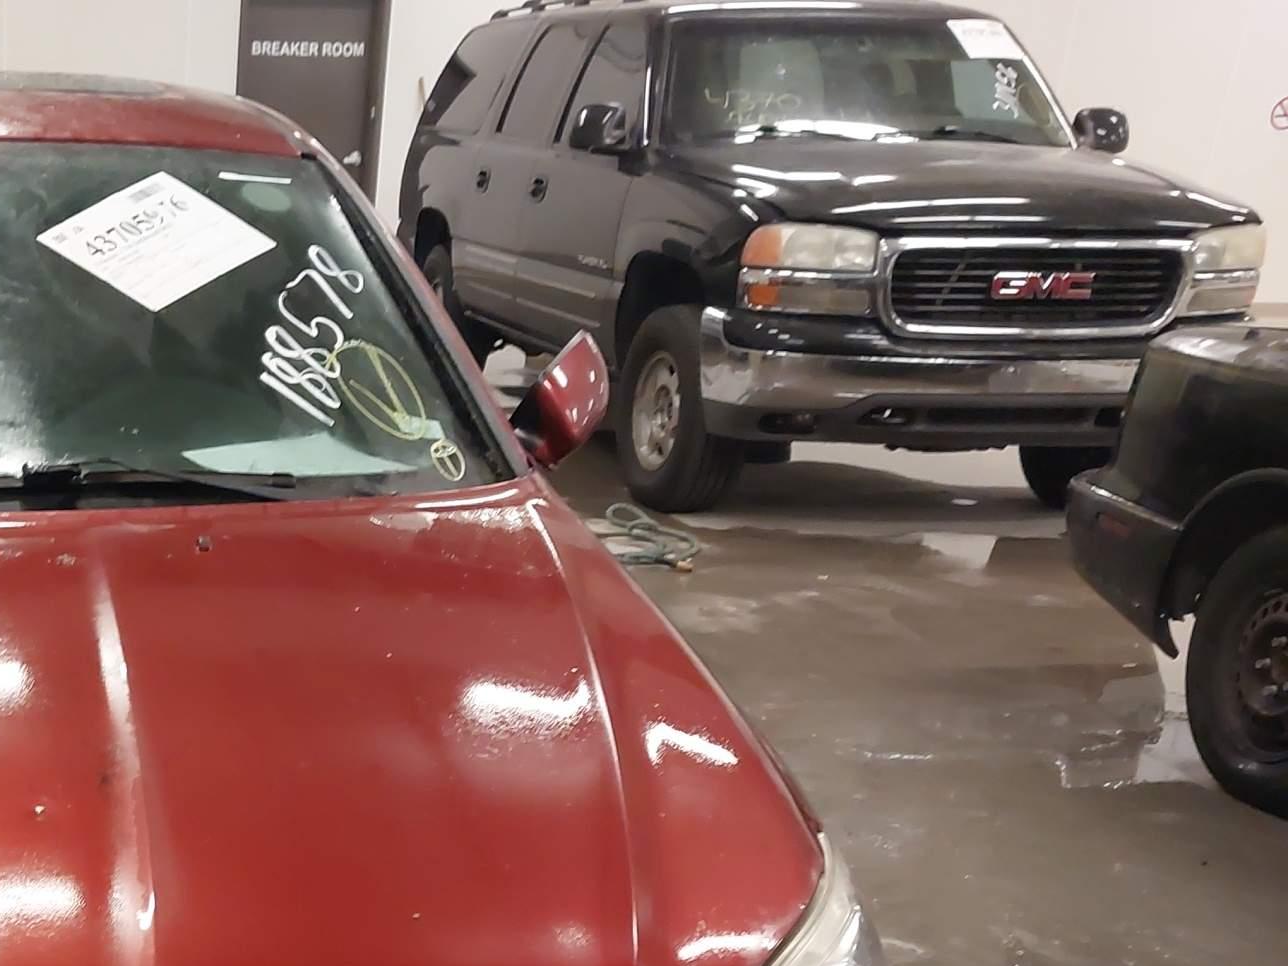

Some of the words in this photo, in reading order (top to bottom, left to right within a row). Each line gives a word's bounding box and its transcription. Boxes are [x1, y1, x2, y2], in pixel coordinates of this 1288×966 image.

[251, 40, 319, 57] BREAKER
[321, 41, 365, 57] ROOM
[992, 270, 1096, 300] GMC
